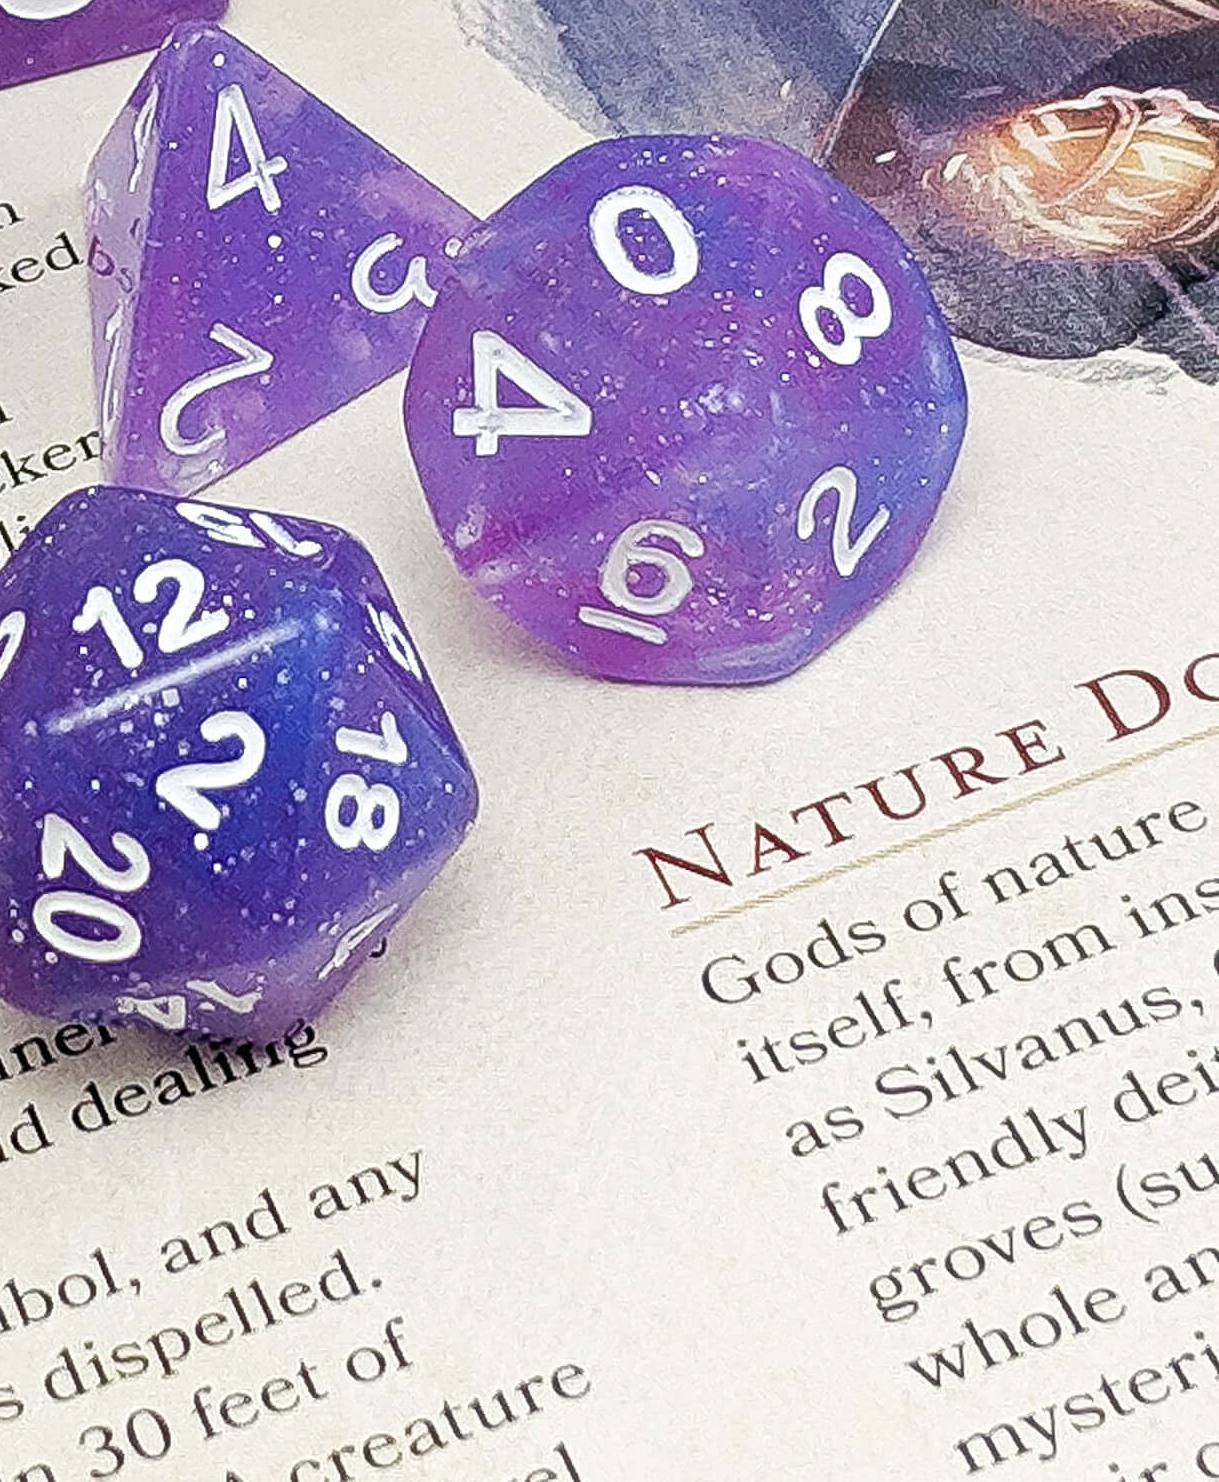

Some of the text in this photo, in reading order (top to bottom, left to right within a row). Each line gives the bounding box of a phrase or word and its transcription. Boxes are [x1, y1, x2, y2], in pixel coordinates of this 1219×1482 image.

[206, 82, 287, 212] 4
[798, 251, 893, 366] 8
[158, 323, 275, 456] 2
[452, 329, 593, 457] 4
[798, 466, 891, 577] 2
[72, 558, 233, 670] 12
[155, 710, 266, 830] 2
[325, 710, 409, 852] 18
[633, 719, 1067, 909] NATURE
[31, 812, 151, 962] 20
[700, 801, 1208, 1005] Gods of nature
[737, 978, 932, 1083] itself,
[943, 923, 1116, 1007] from
[71, 1019, 328, 1133] dealing
[785, 986, 1204, 1157] as Silvanus,
[159, 1187, 291, 1274] and
[309, 1149, 424, 1222] any
[821, 1106, 1088, 1236] friendly
[44, 1248, 382, 1403] dispelled.
[869, 1200, 1103, 1322] groves
[78, 1317, 413, 1478] 30 feet of
[906, 1285, 1127, 1387] whole
[289, 1363, 592, 1482] creature
